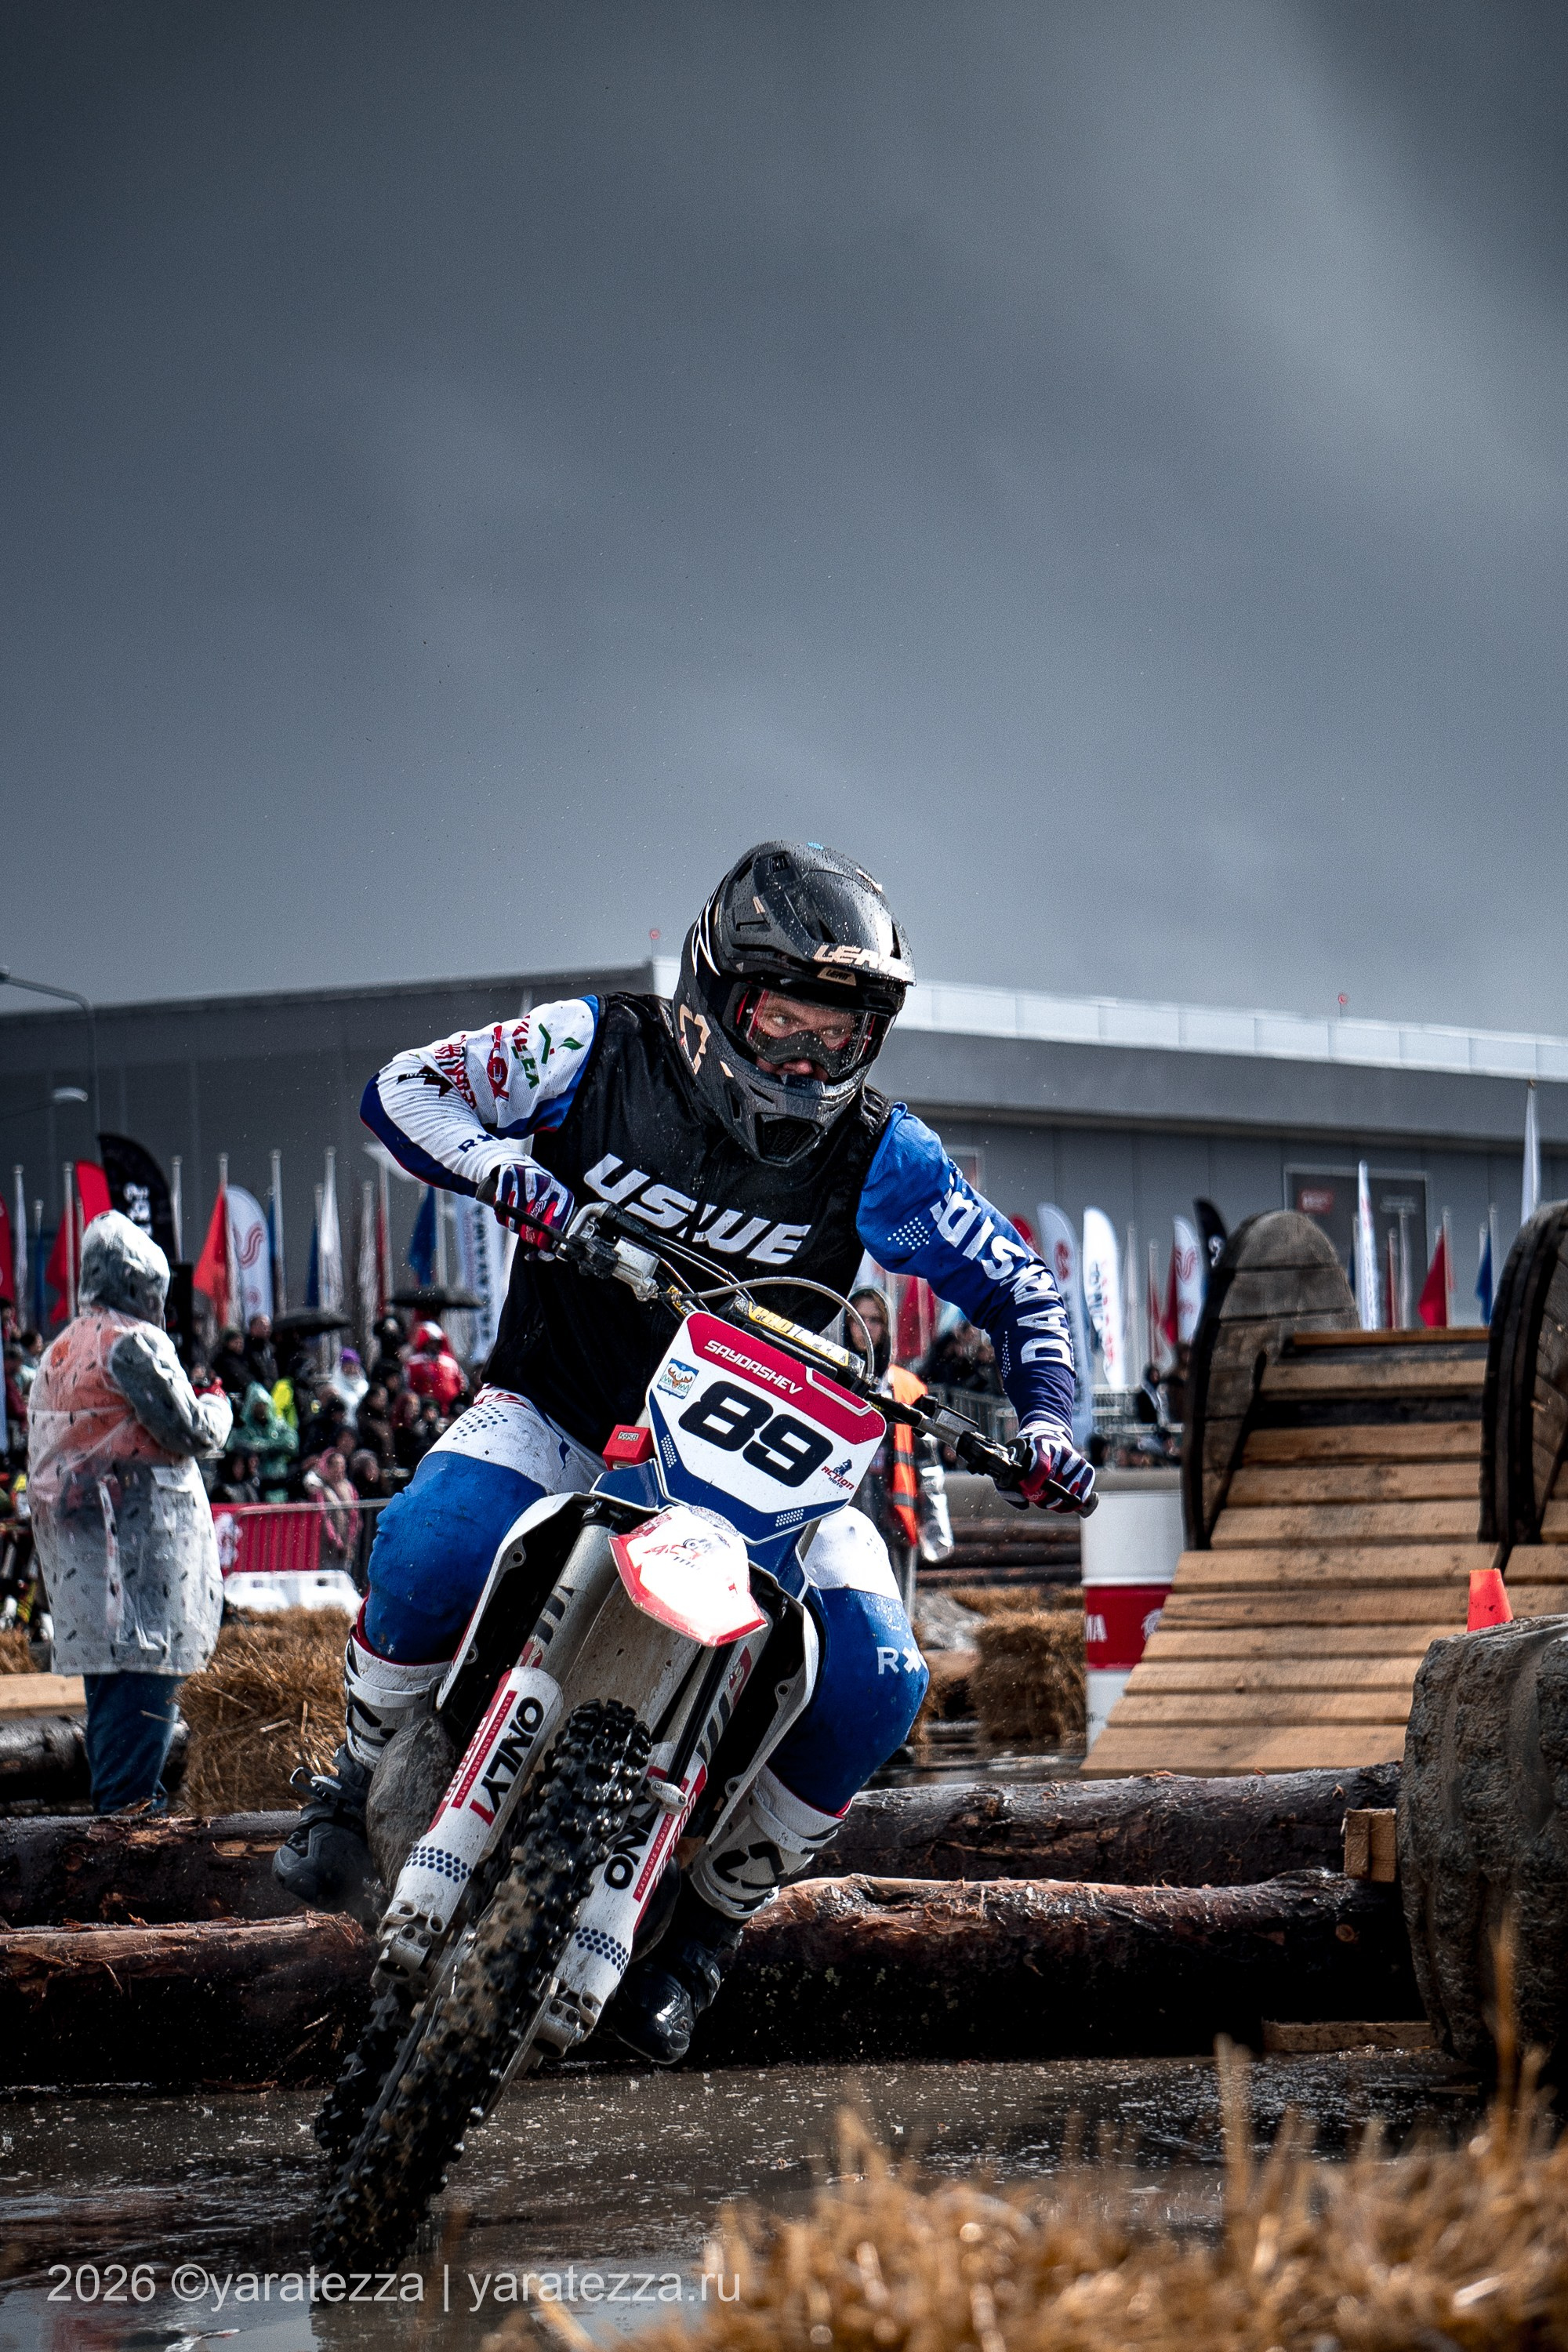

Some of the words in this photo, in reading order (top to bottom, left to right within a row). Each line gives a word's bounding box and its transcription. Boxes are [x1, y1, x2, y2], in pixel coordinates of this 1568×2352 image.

[583, 1152, 812, 1265] USWE
[704, 1339, 804, 1395] SAYDASHEV
[678, 1380, 833, 1488] 89
[821, 1465, 855, 1491] ACTION
[490, 1697, 511, 1736] EXTREME
[473, 1738, 492, 1771] ENDURO
[457, 1775, 473, 1801] PARTS
[636, 1853, 659, 1894] EXTREME
[655, 1815, 673, 1850] ENDURO
